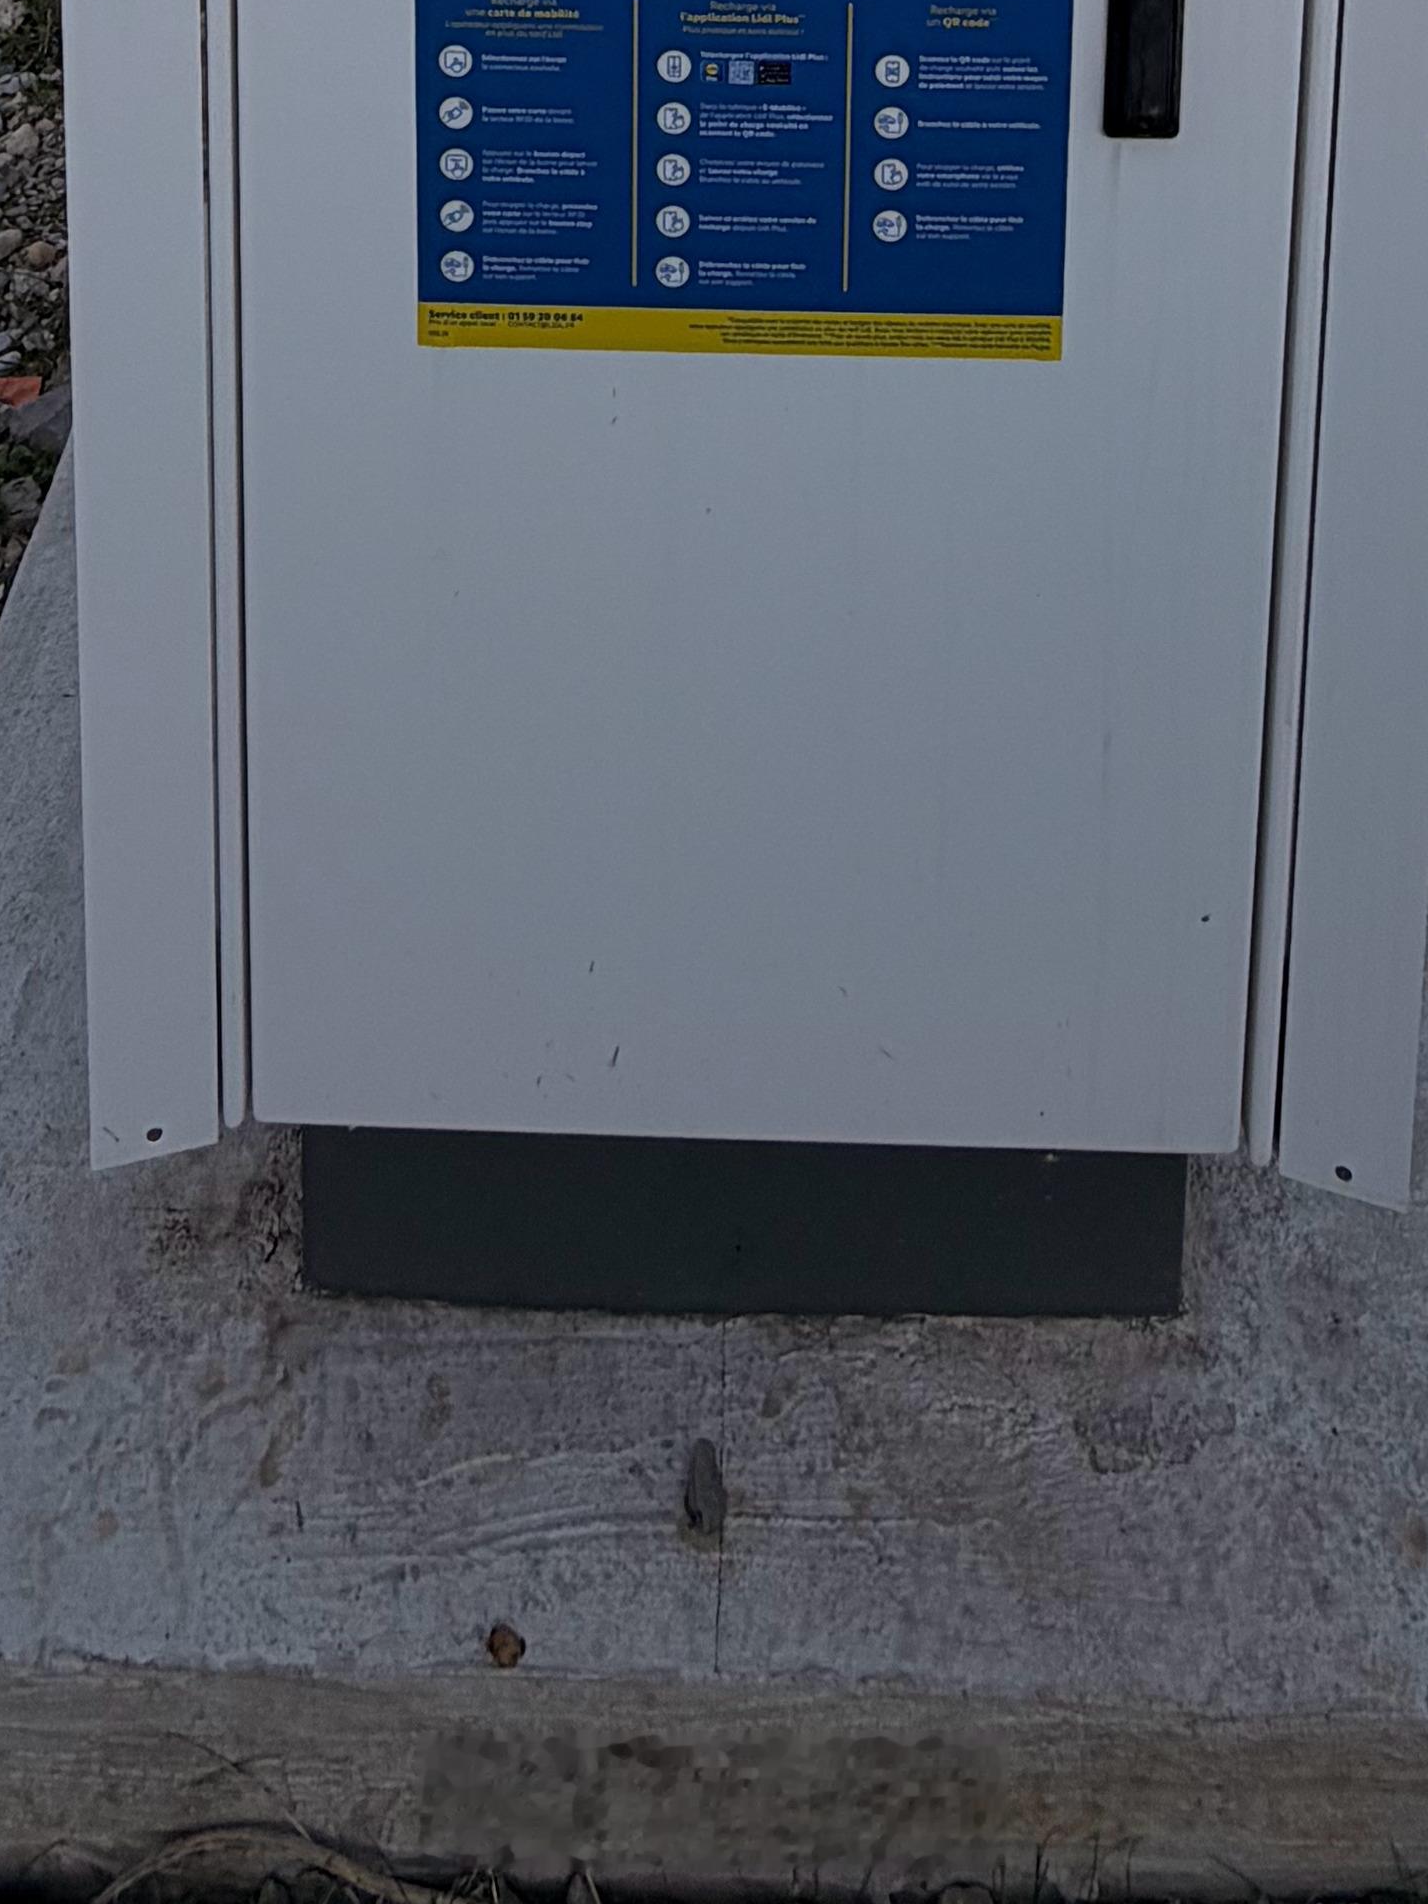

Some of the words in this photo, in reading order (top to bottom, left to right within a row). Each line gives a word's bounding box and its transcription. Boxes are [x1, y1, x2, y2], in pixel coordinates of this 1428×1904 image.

[487, 9, 515, 18] carte
[517, 9, 531, 18] de
[534, 9, 580, 19] mobilité
[680, 11, 749, 24] l'application
[751, 13, 773, 24] Lidl
[943, 18, 960, 29] QR
[429, 309, 467, 319] Service
